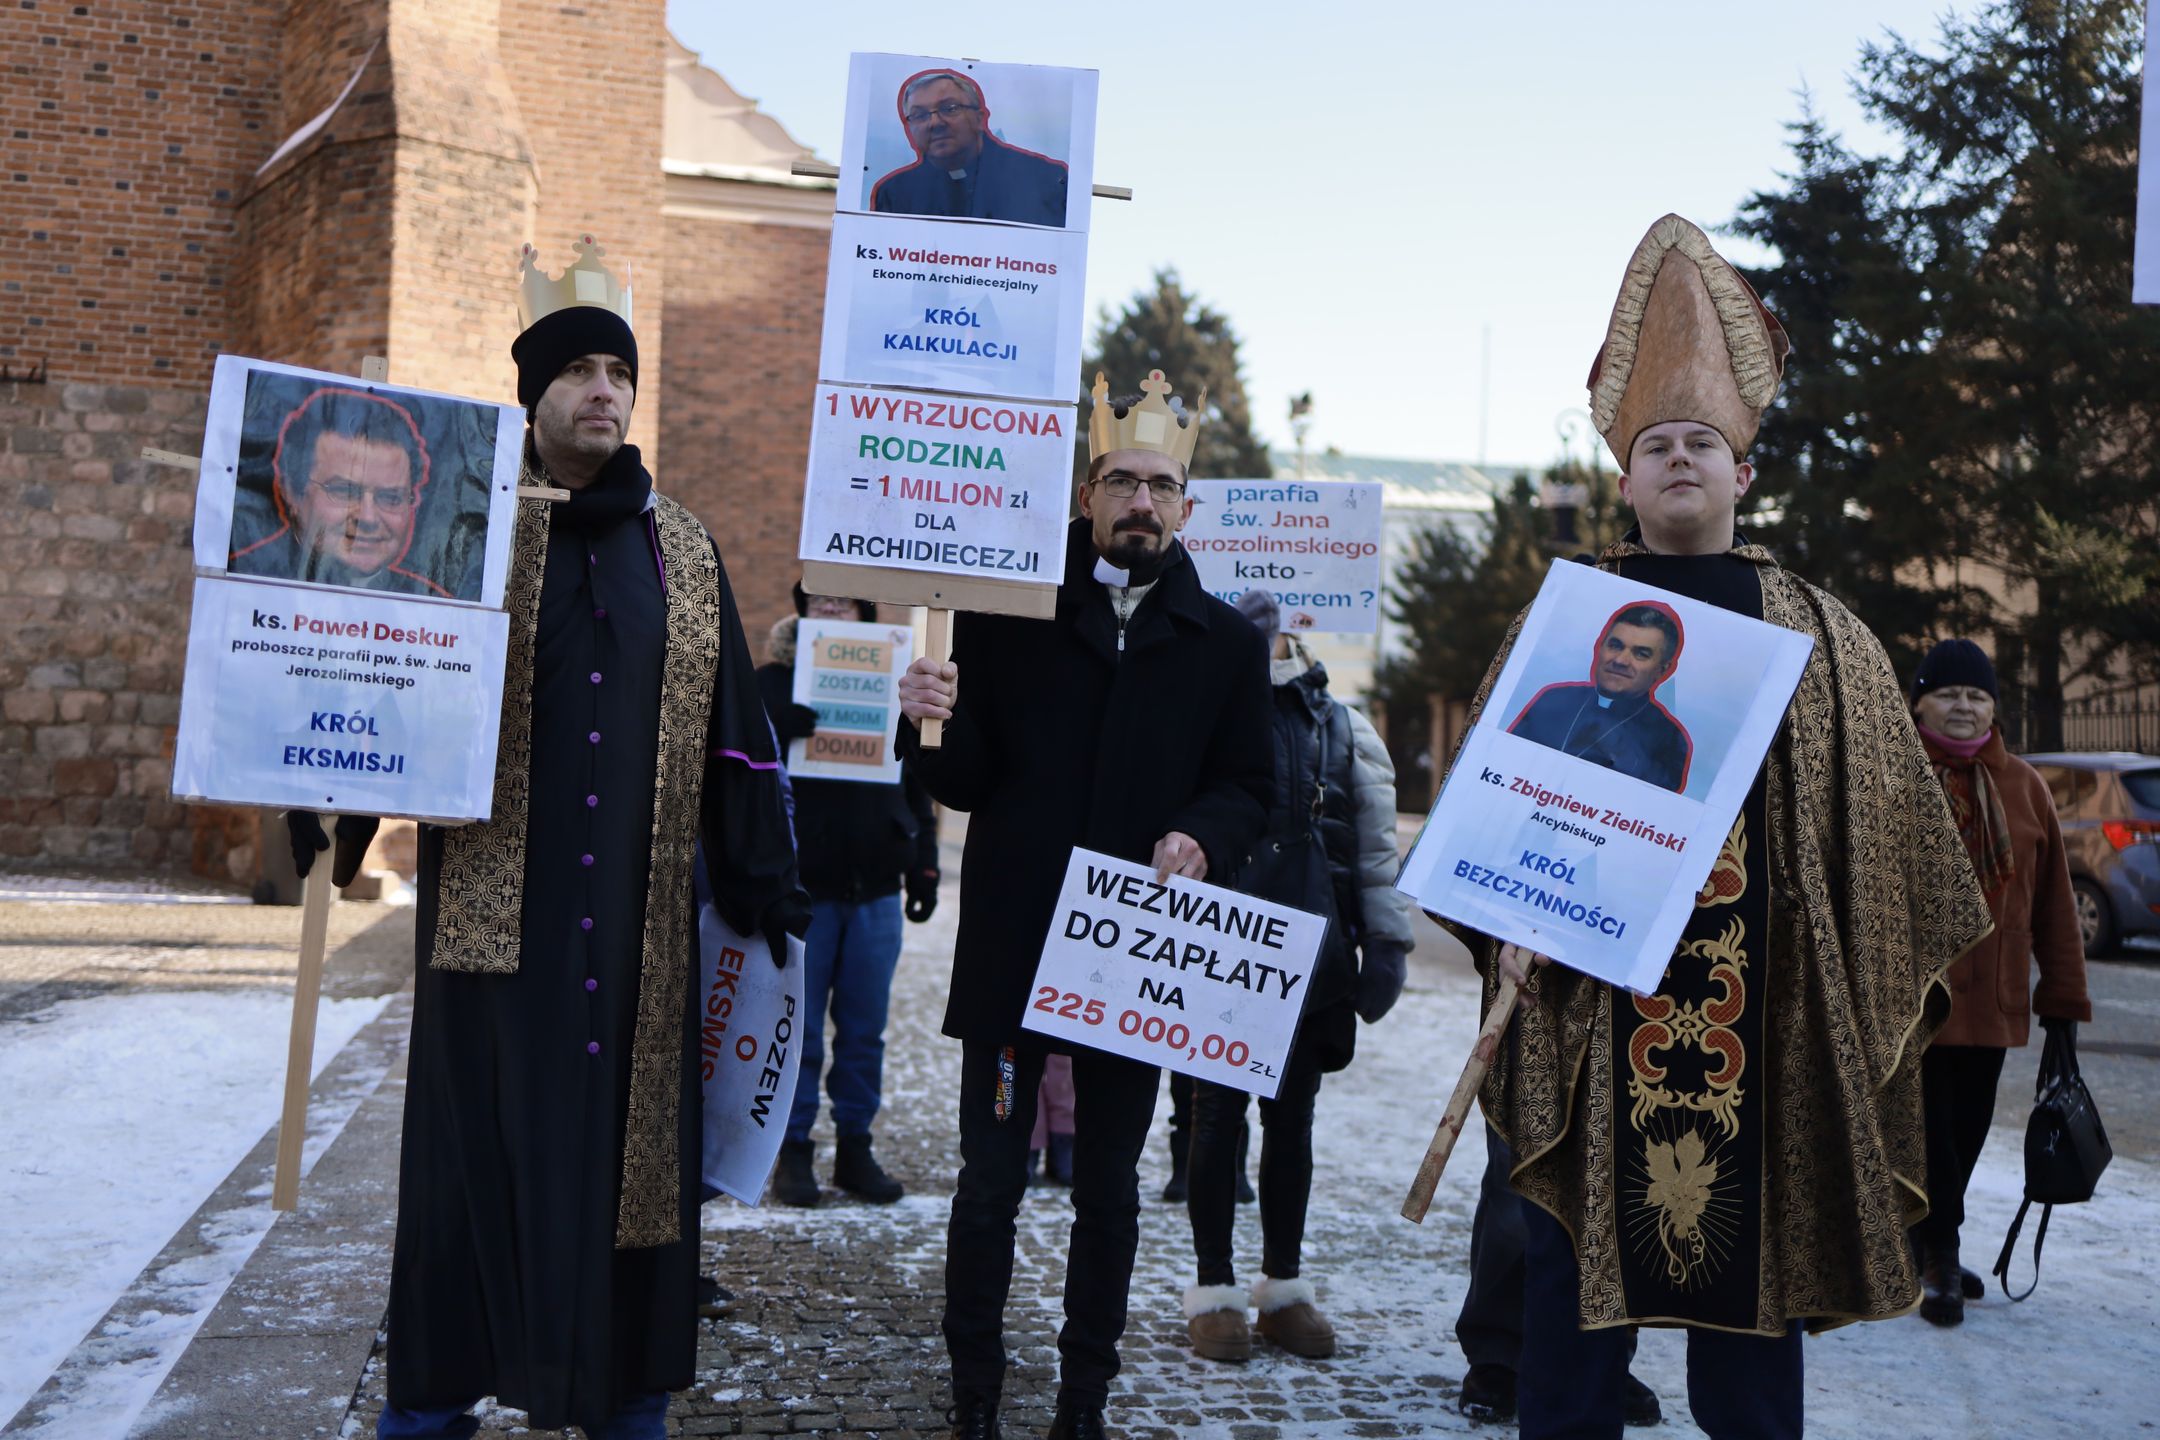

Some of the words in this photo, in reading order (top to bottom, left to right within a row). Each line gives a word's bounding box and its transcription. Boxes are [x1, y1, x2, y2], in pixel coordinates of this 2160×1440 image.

[856, 244, 883, 260] ks.
[888, 247, 992, 268] Waldemar
[996, 256, 1058, 275] Hanas
[873, 268, 926, 282] Ekonom
[929, 272, 1039, 295] Archidiecezjalny
[925, 306, 981, 328] KRÓL
[884, 333, 1017, 361] KALKULACJI
[826, 393, 839, 416] 1
[850, 394, 1062, 437] WYRZUCONA
[859, 434, 1006, 471] RODZINA
[850, 477, 868, 490] =
[878, 475, 890, 497] 1
[900, 477, 1003, 508] MILION
[1009, 491, 1029, 509] zł
[1227, 484, 1319, 504] parafia
[914, 512, 956, 531] DLA
[1221, 508, 1263, 527] św.
[1271, 510, 1330, 528] Jana
[826, 532, 1039, 573] ARCHIDIECEZJI
[1235, 560, 1296, 579] kato
[252, 609, 287, 630] ks.
[293, 614, 369, 640] Paweł
[373, 623, 458, 649] Deskur
[232, 638, 314, 658] proboszcz
[317, 647, 371, 663] parafii
[373, 654, 401, 668] pw.
[404, 654, 430, 669] św.
[433, 658, 472, 673] Jana
[828, 644, 881, 667] CHCĘ
[286, 664, 415, 690] Jerozolimskiego
[818, 675, 885, 693] ZOSTAĆ
[310, 710, 379, 737] KRÓL
[835, 709, 881, 725] MOIM
[283, 745, 404, 774] EKSMISJI
[815, 737, 876, 758] DOMU
[1479, 766, 1506, 788] ks.
[1509, 776, 1600, 819] Zbigniew
[1600, 809, 1687, 852] Zieliński
[1530, 811, 1606, 847] Arcybiskup
[1519, 849, 1576, 885] KRÓL
[1086, 865, 1289, 949] WEZWANIE
[1453, 859, 1626, 939] BEZCZYNNOŚCI
[1064, 910, 1121, 949] DO
[1128, 927, 1302, 1000] ZAPŁATY
[1138, 977, 1185, 1011] NA
[1033, 986, 1107, 1026] 225
[1118, 1009, 1250, 1067] 000,00
[735, 1035, 757, 1061] O
[750, 994, 796, 1128] POZEW
[1003, 1062, 1013, 1081] 30
